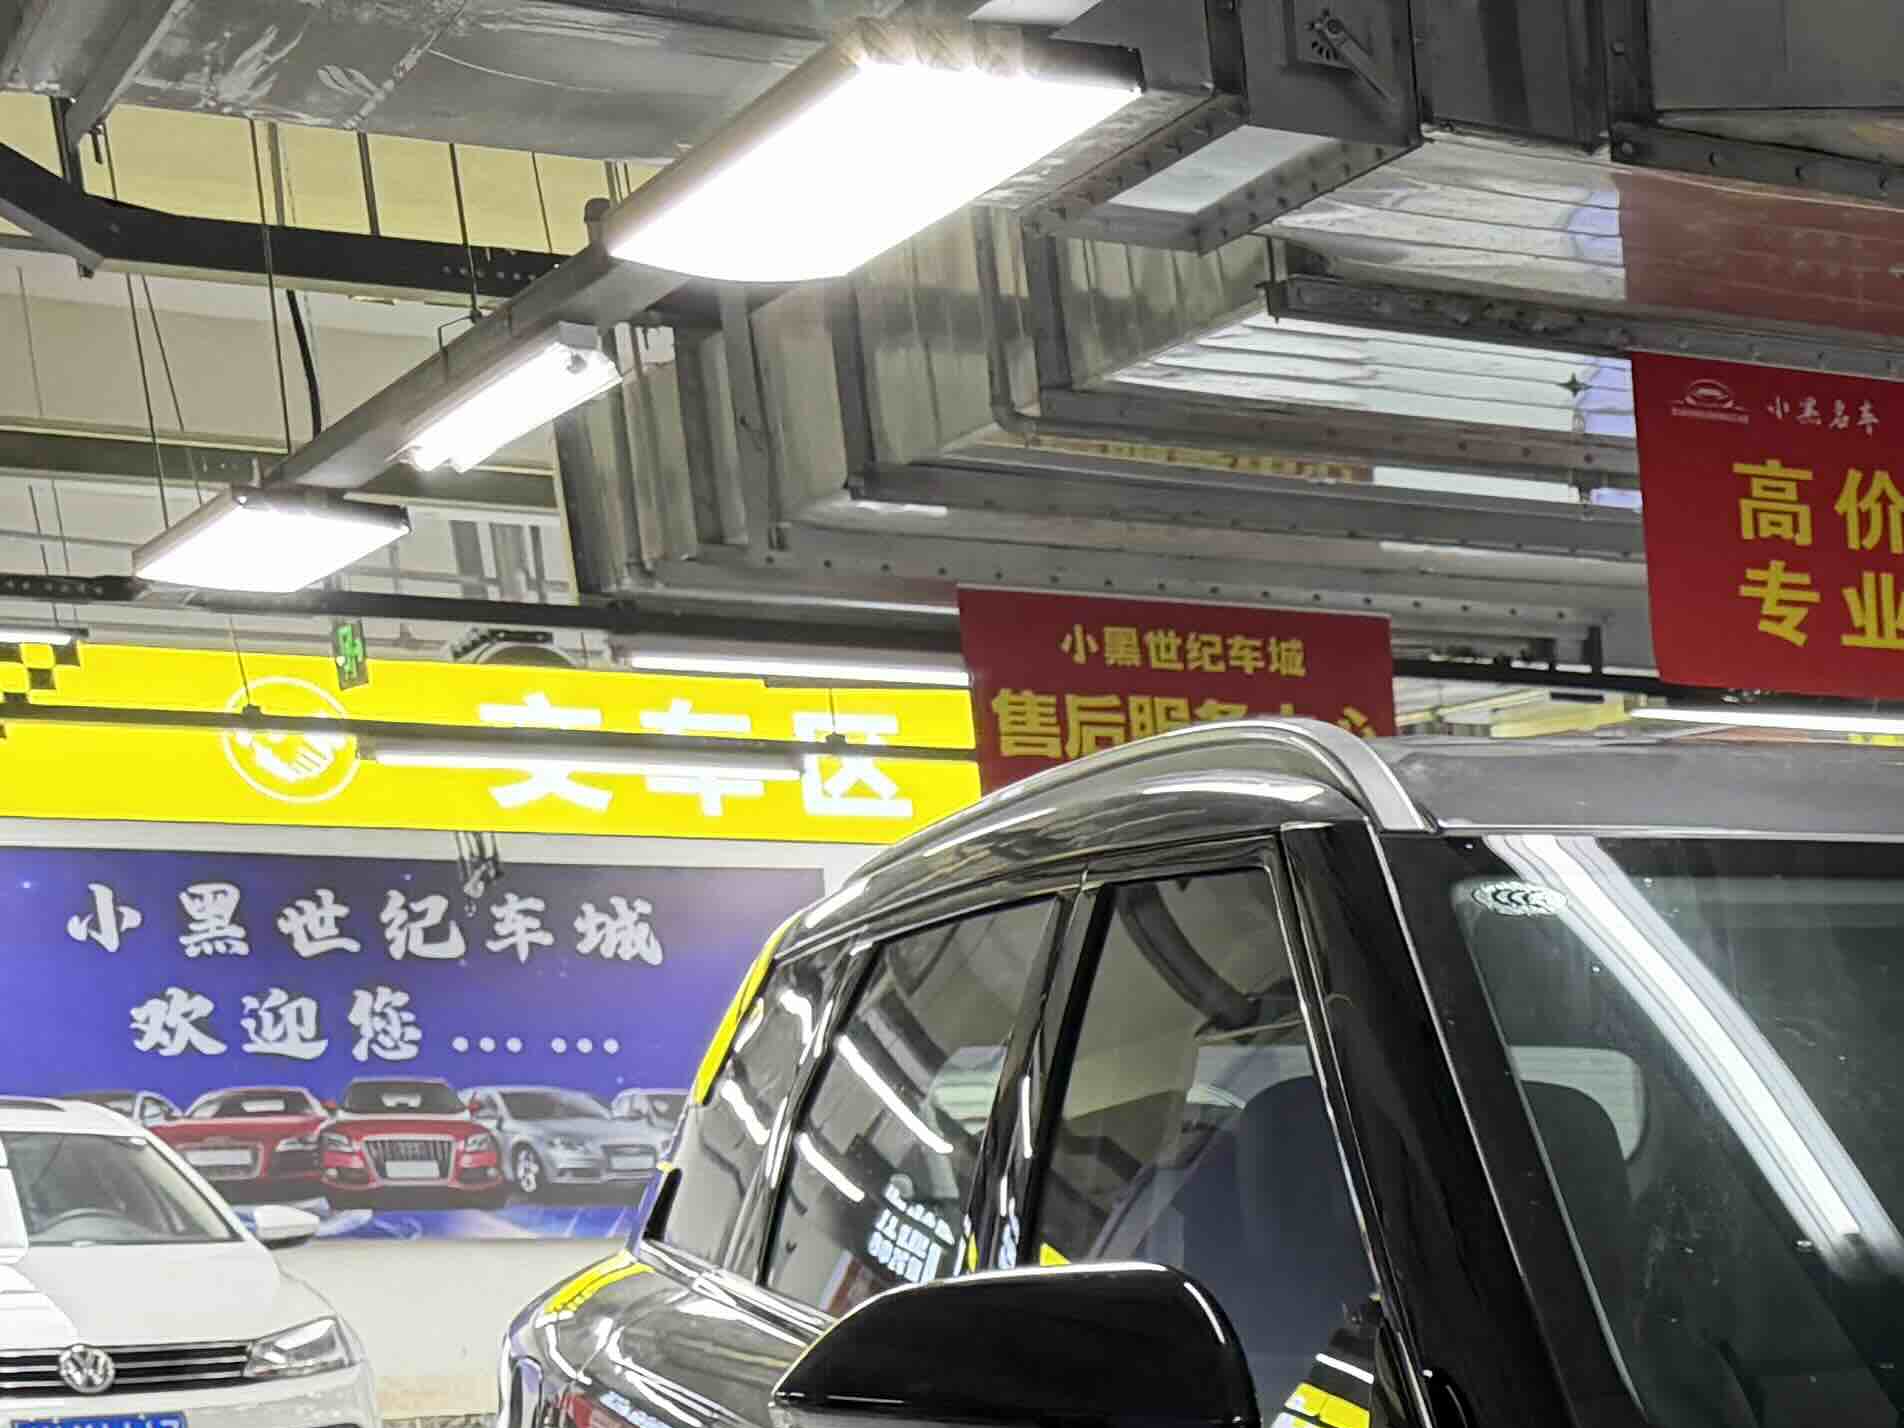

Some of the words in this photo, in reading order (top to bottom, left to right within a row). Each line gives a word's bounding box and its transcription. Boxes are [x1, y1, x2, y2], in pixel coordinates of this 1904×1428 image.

[1060, 623, 1307, 678] 小黑世纪车城
[991, 689, 1376, 758] 售后服
[65, 881, 666, 967] 小黑世纪车城
